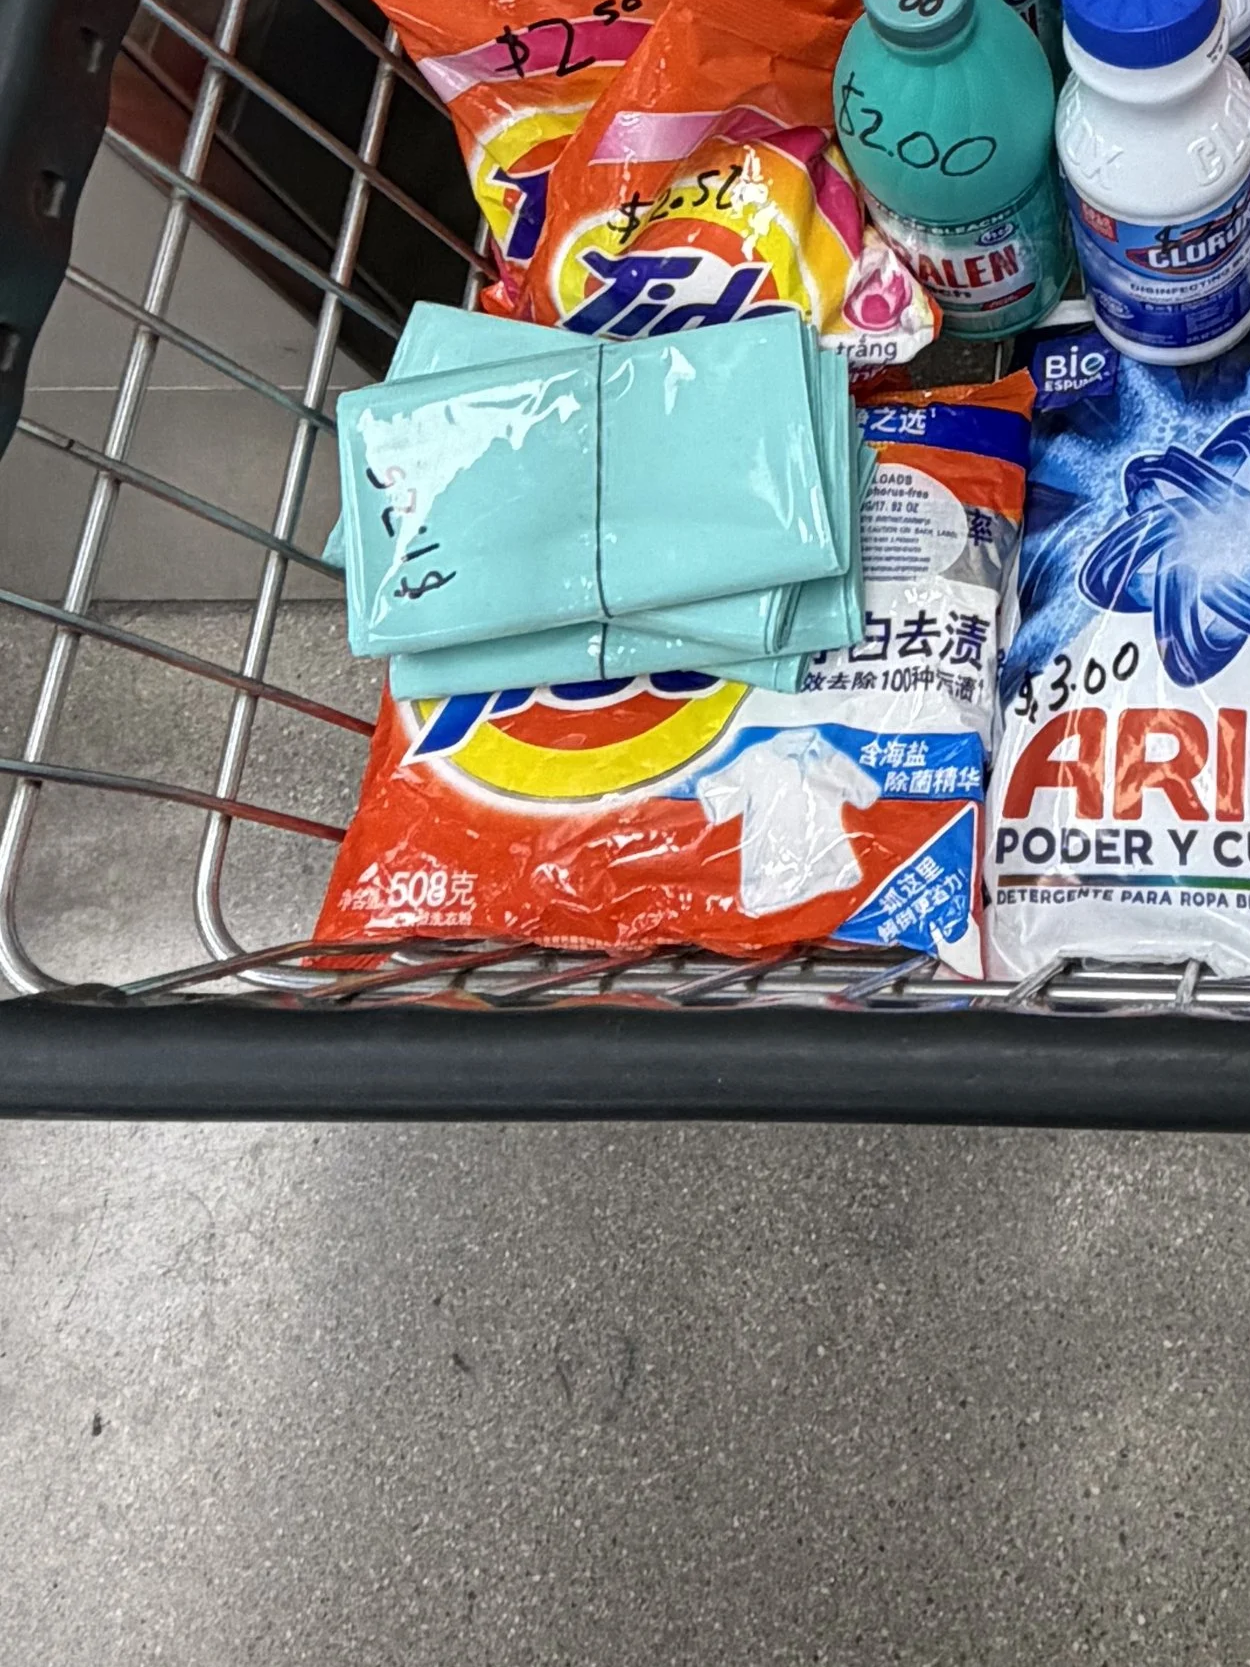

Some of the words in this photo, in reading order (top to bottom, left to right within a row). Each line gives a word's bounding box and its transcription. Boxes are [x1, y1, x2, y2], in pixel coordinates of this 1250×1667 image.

[838, 70, 997, 177] $2.00
[918, 243, 1020, 289] ALEN
[836, 334, 898, 361] trắng
[866, 486, 929, 500] phorus-free
[812, 609, 991, 671] 白去渍
[859, 739, 930, 769] 含海盐
[884, 766, 981, 795] 除菌精华
[994, 826, 1152, 867] PODER
[1163, 827, 1198, 864] Y
[878, 854, 945, 916] 抓这里
[996, 886, 1114, 906] DETERGENTE
[1120, 888, 1173, 907] PARA
[1179, 889, 1230, 908] ROPA
